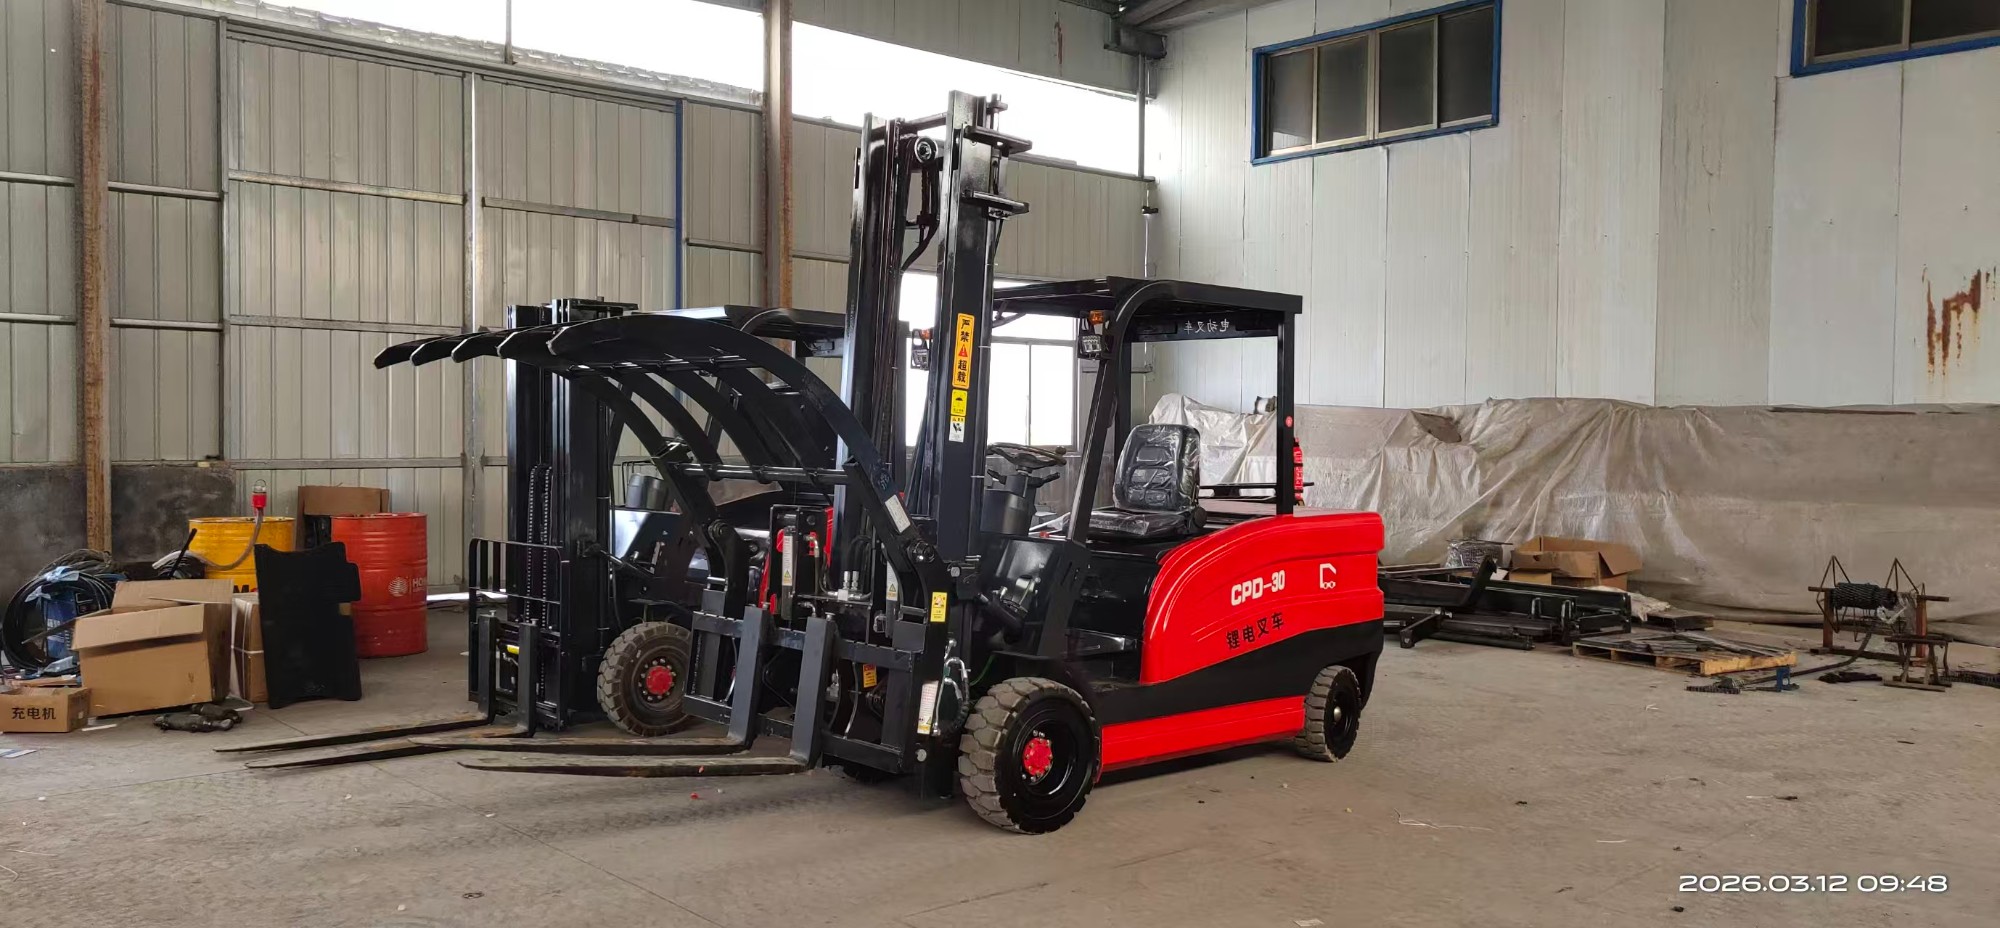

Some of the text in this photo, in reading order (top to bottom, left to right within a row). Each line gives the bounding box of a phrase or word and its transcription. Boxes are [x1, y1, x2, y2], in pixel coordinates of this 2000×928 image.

[1231, 569, 1286, 606] CPD-30
[1226, 612, 1284, 650] 锂电叉车
[11, 707, 57, 720] 充电机
